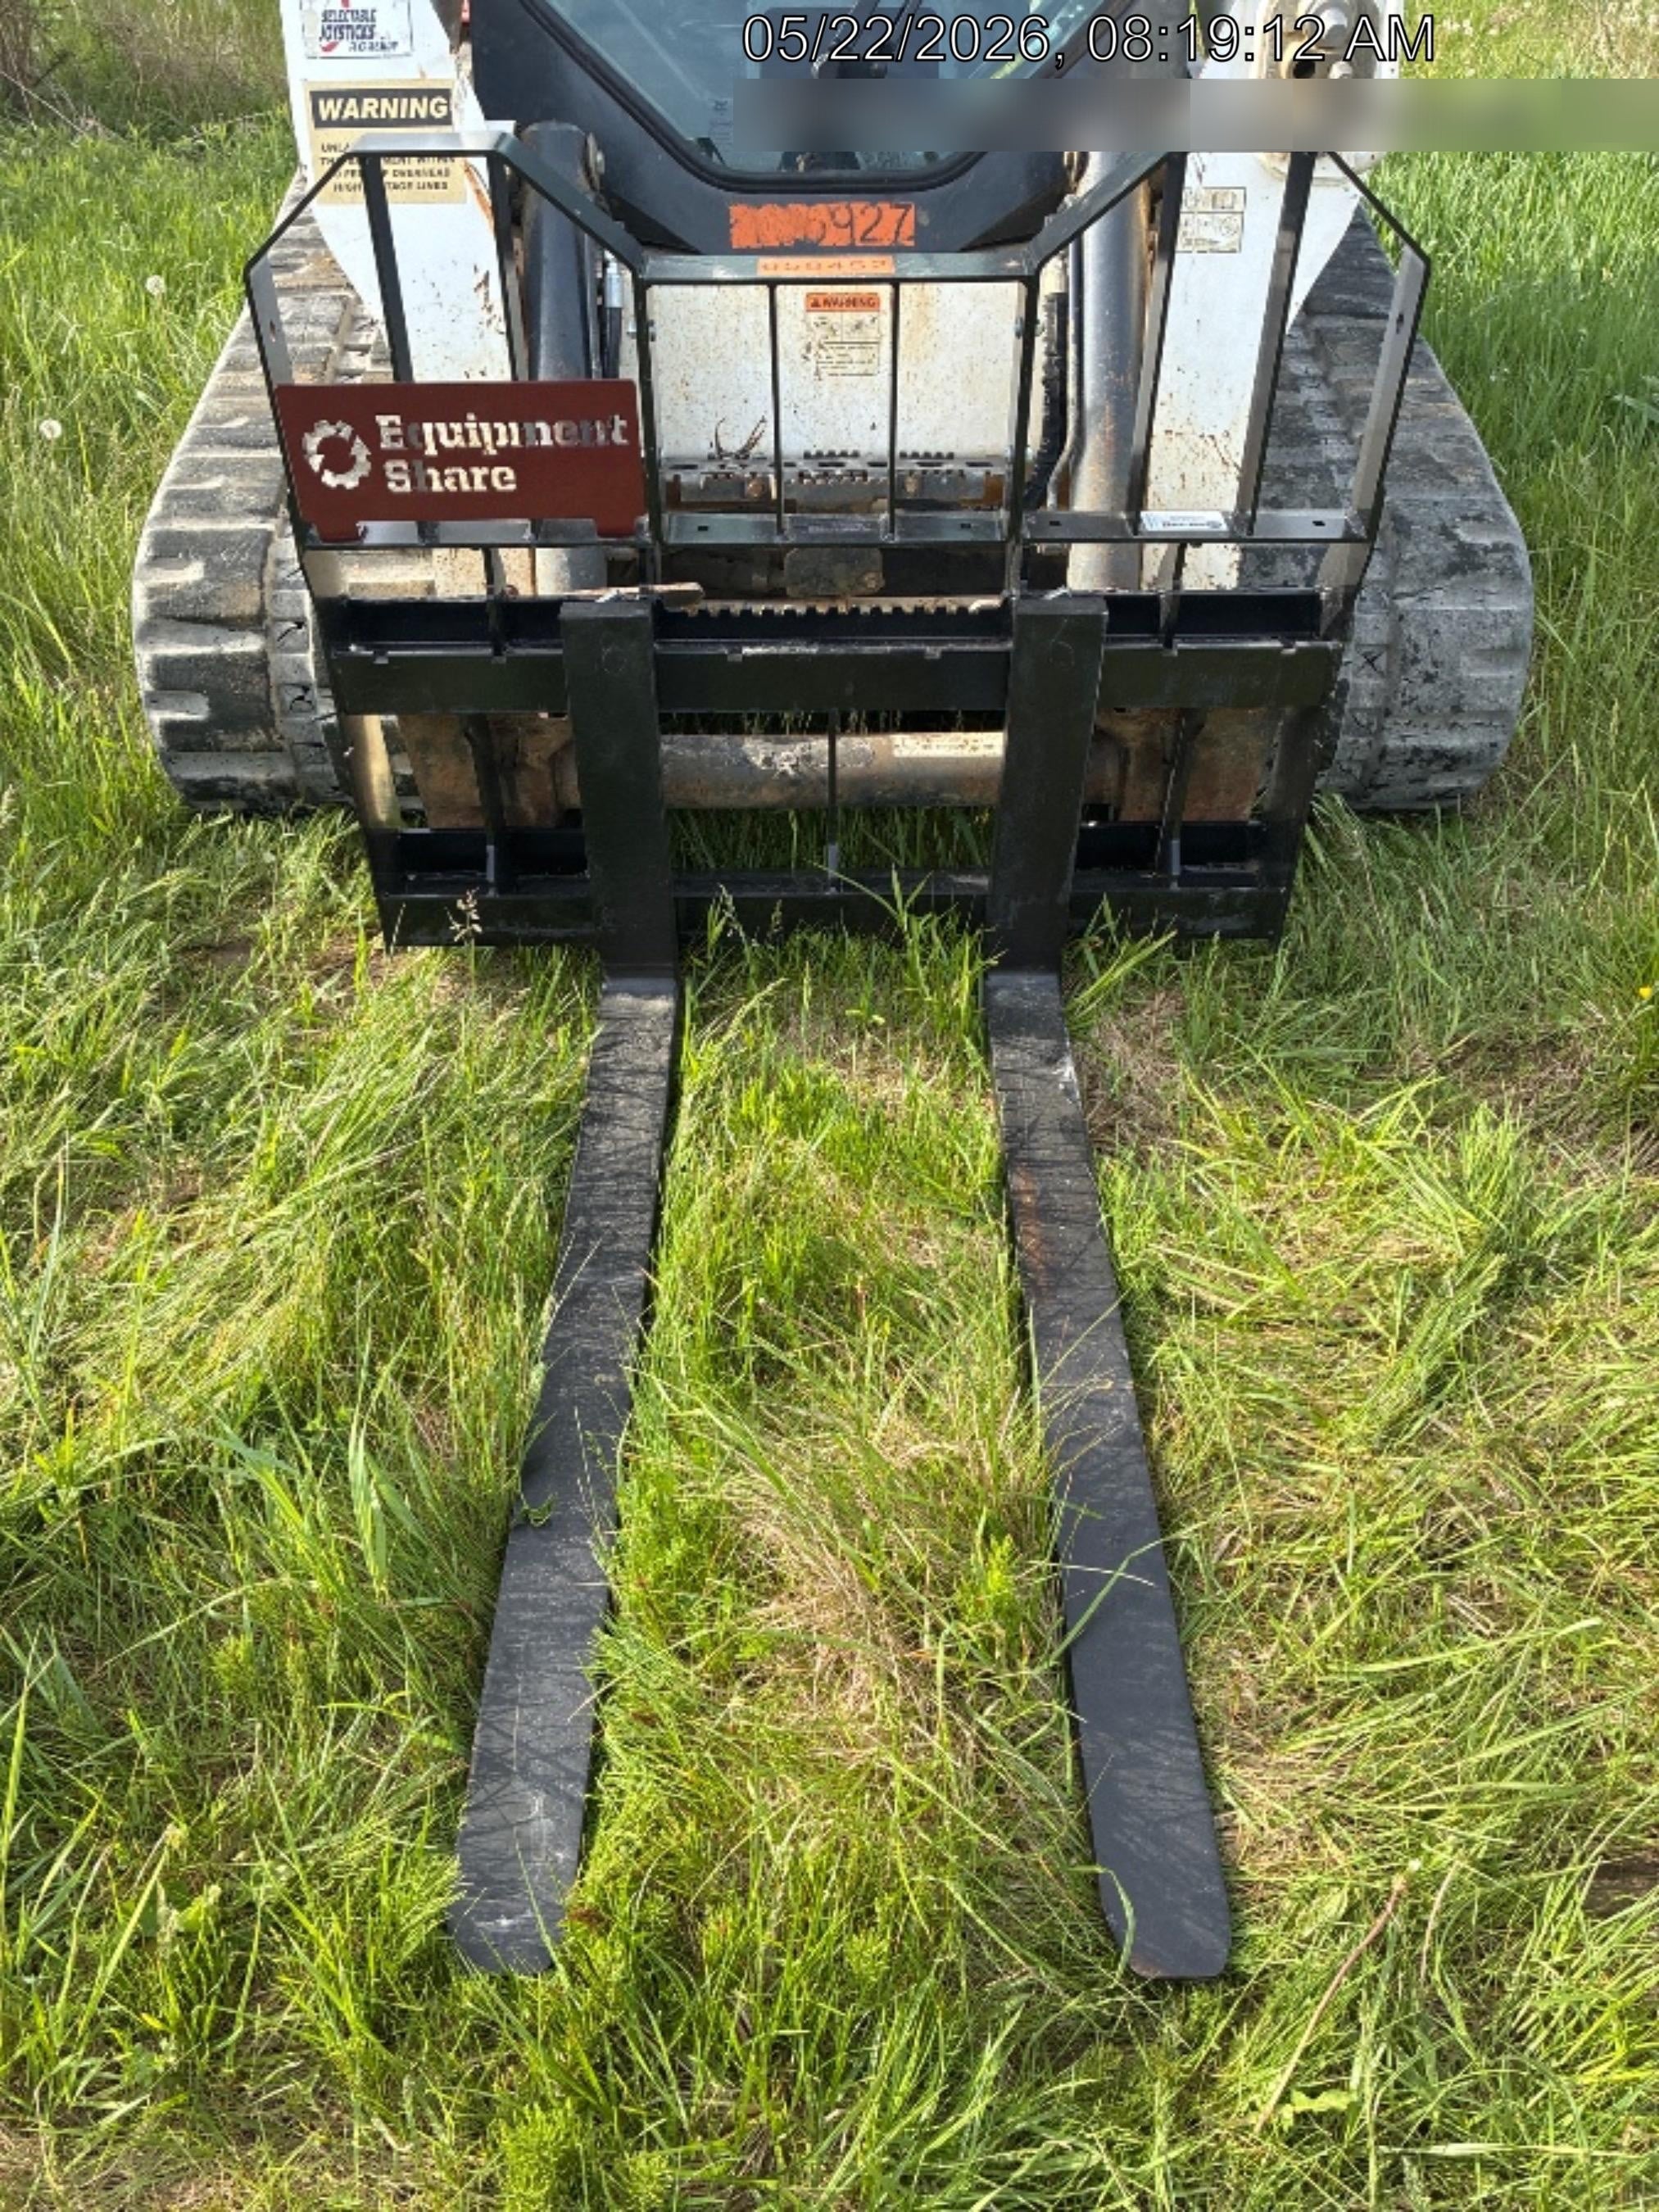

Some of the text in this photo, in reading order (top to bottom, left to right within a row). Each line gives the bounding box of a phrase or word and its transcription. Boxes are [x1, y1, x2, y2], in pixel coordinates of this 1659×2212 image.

[321, 9, 377, 23] SELECTABLE
[320, 24, 376, 42] JOYSTICKS
[319, 97, 449, 121] WARNING
[374, 411, 629, 456] Equipment
[383, 458, 518, 493] Share
